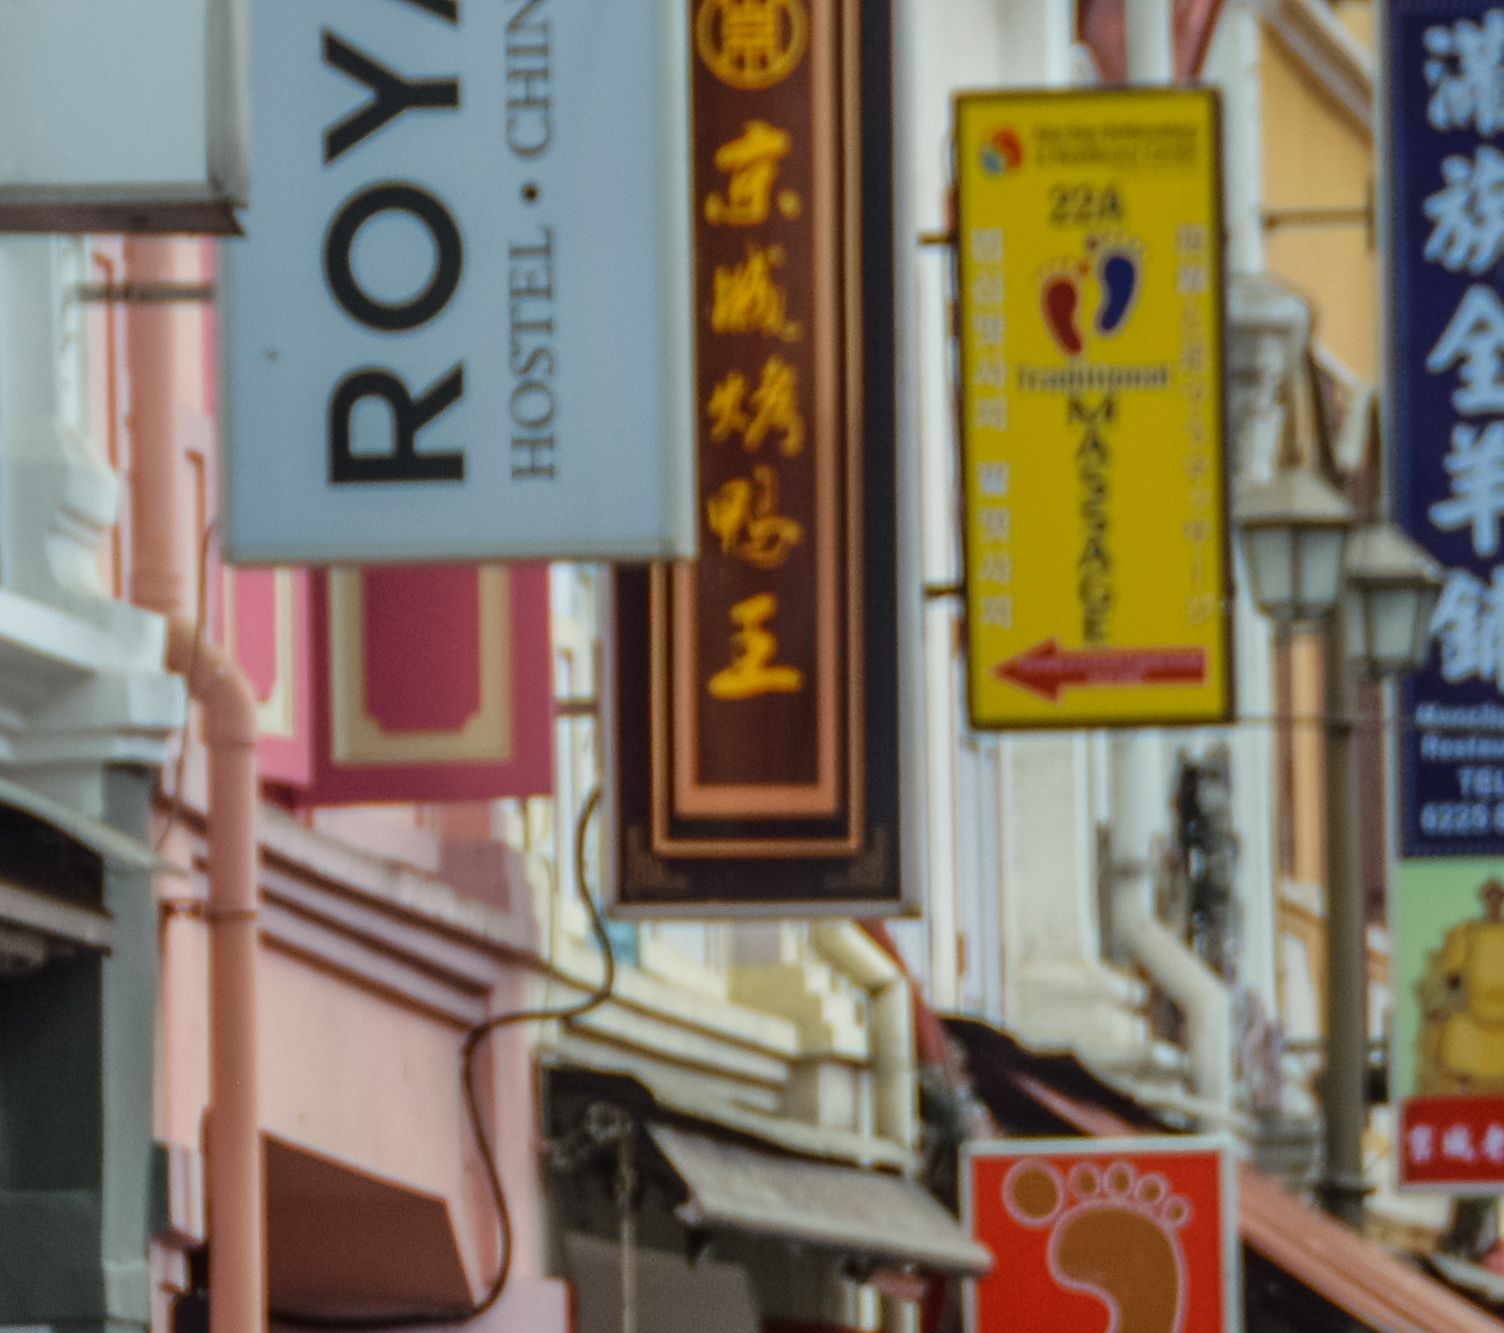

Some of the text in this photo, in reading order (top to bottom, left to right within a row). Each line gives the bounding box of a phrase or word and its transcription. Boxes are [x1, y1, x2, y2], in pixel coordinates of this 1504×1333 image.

[322, 0, 466, 486] ROY
[1049, 184, 1124, 228] 22A
[508, 224, 558, 482] HOSTEL
[1066, 393, 1120, 645] MASSAGE
